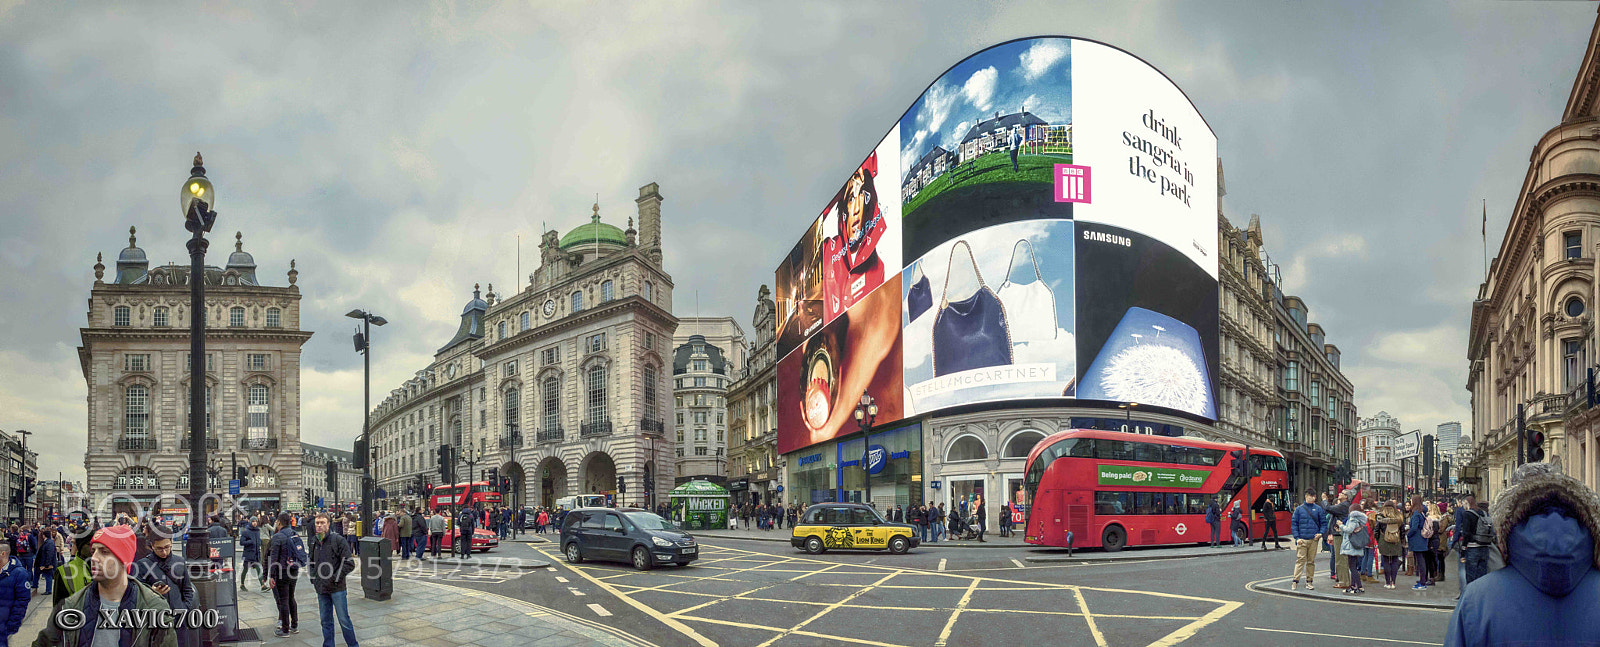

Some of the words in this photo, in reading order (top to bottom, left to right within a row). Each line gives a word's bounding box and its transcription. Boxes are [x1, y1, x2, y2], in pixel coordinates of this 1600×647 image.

[1142, 109, 1183, 151] drink
[1122, 131, 1182, 176] sangria
[1184, 162, 1194, 187] in
[1129, 156, 1157, 184] the
[1160, 175, 1192, 208] park
[1083, 230, 1132, 247] SAMSUNG
